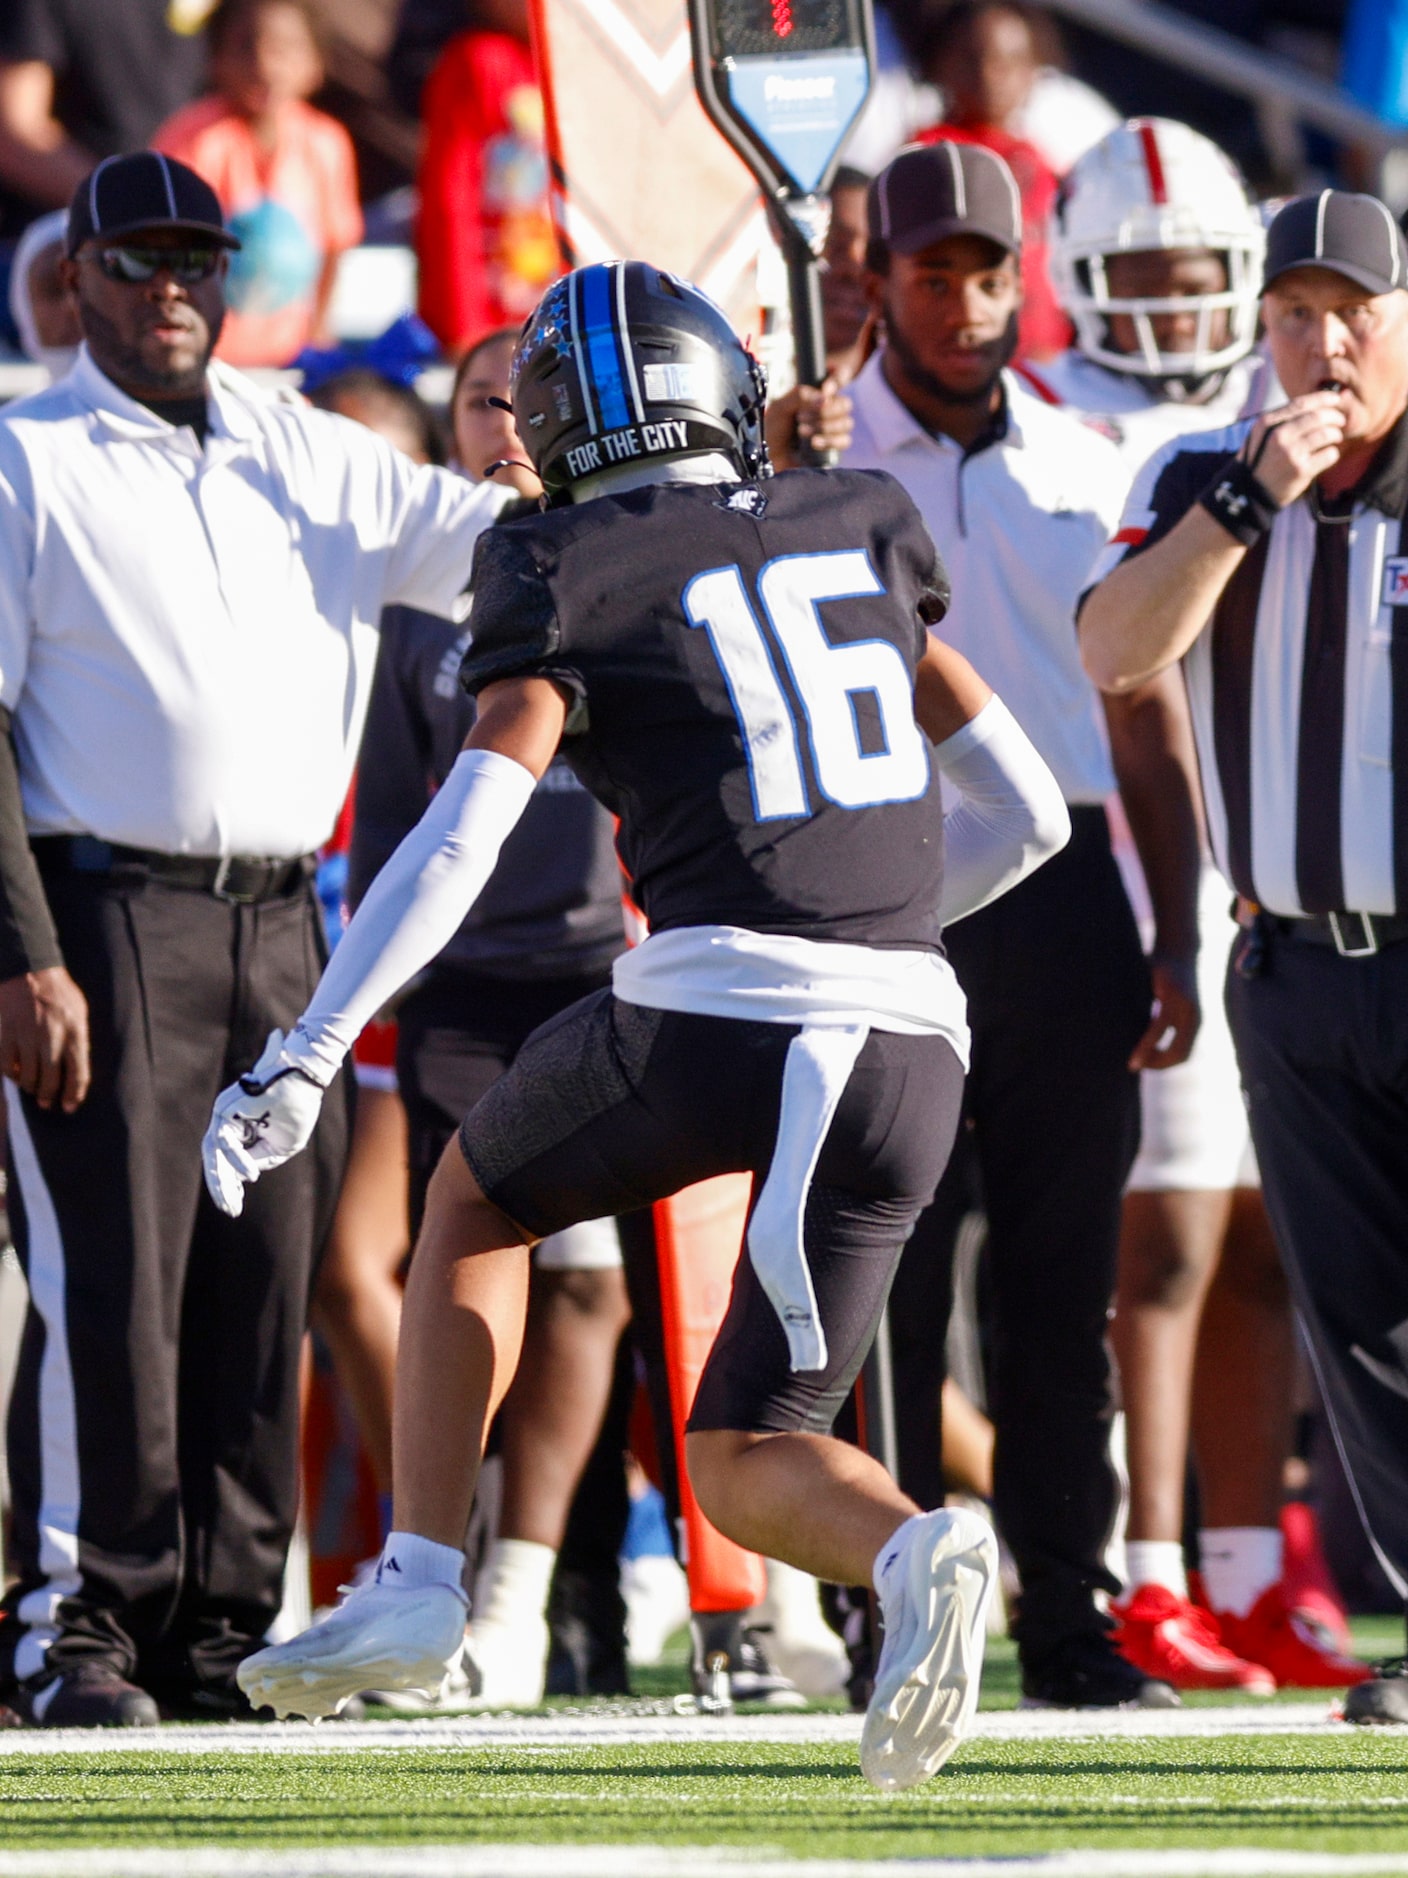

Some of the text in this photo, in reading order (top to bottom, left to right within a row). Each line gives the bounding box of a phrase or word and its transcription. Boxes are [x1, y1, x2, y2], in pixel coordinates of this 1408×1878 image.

[565, 420, 689, 478] FOR THE CITY
[681, 548, 931, 823] 16
